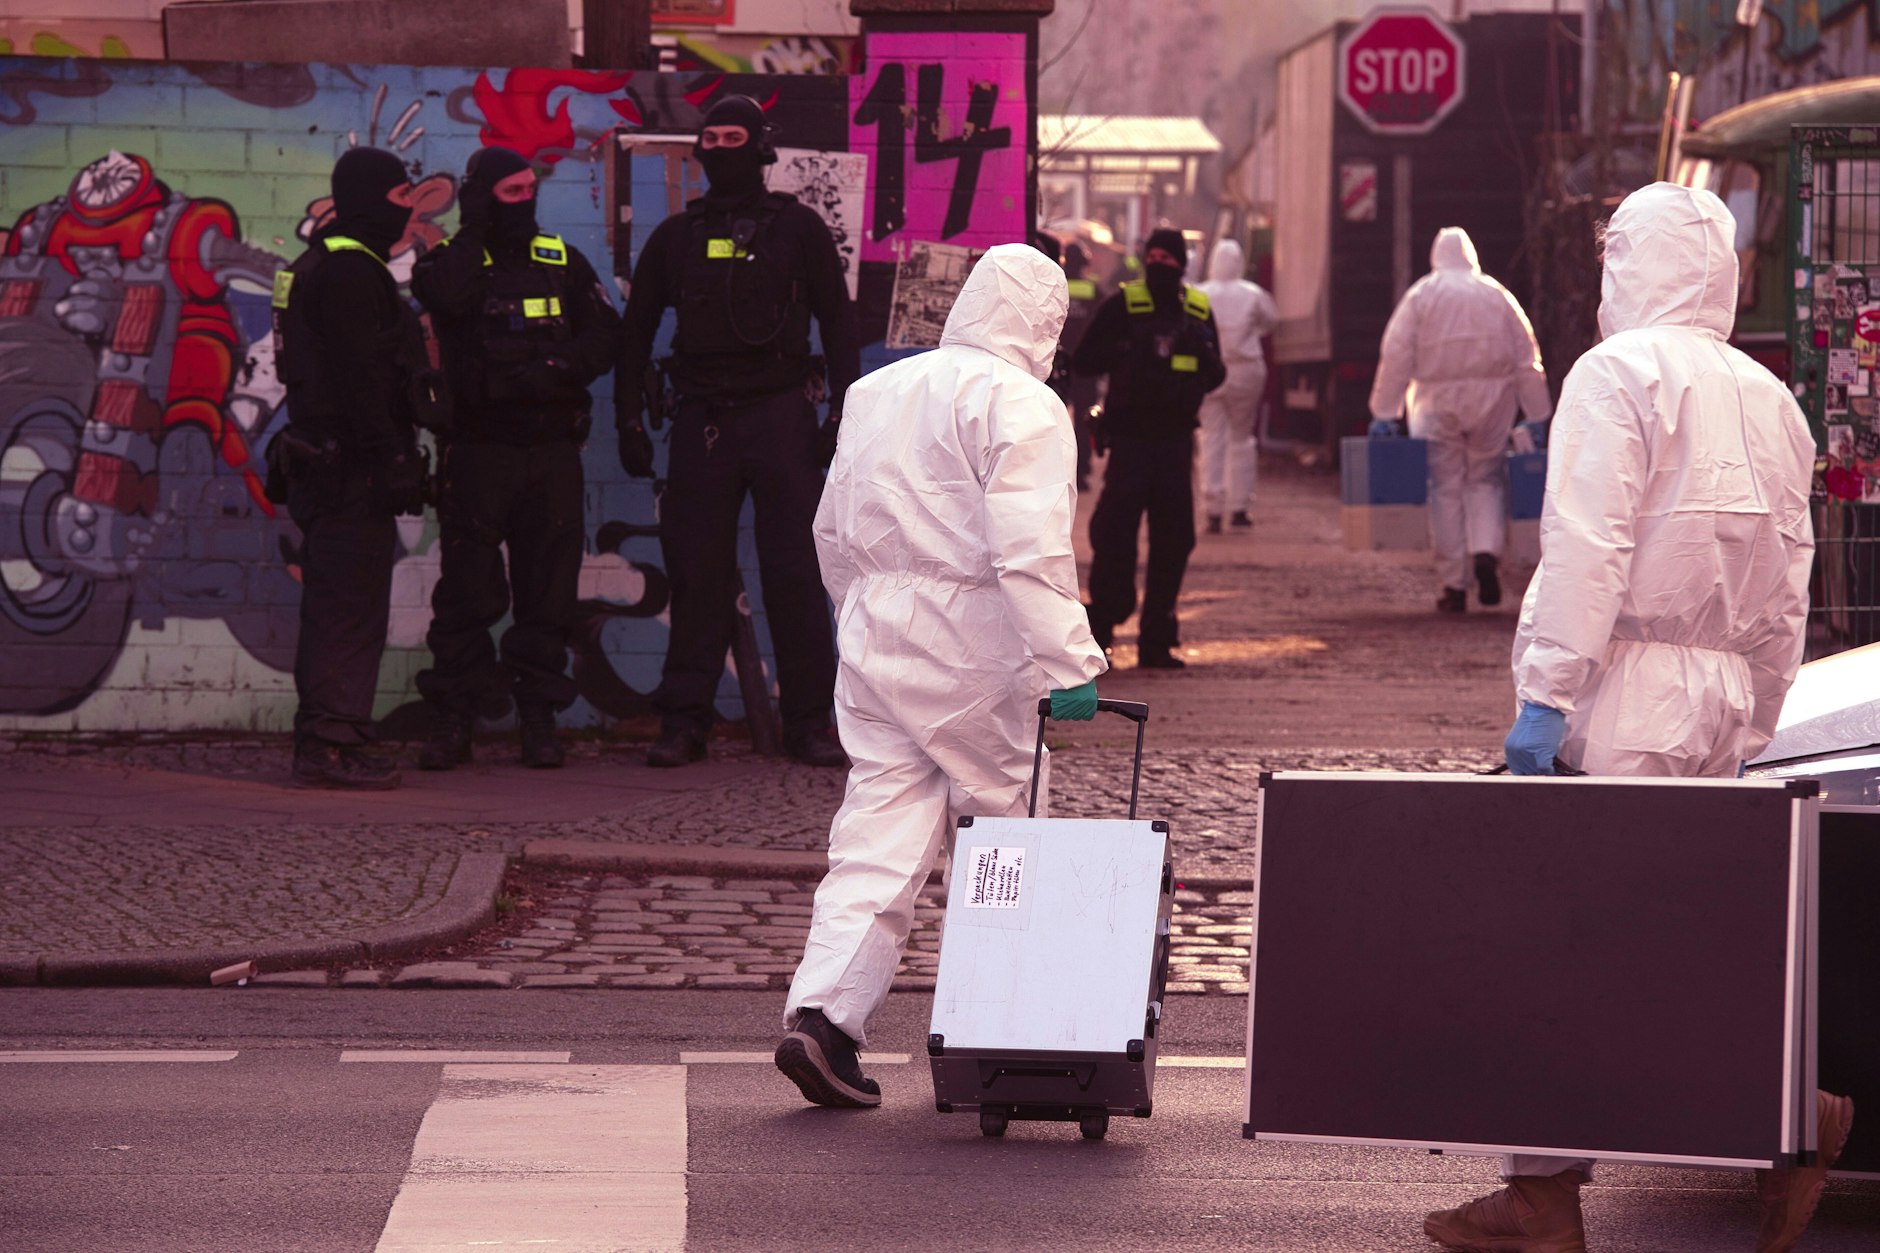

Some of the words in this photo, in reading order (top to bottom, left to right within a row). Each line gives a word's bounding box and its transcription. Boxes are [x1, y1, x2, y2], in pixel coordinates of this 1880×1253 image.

[1354, 47, 1448, 94] STOP
[853, 62, 1012, 243] 14
[971, 854, 986, 904] Verpackungen
